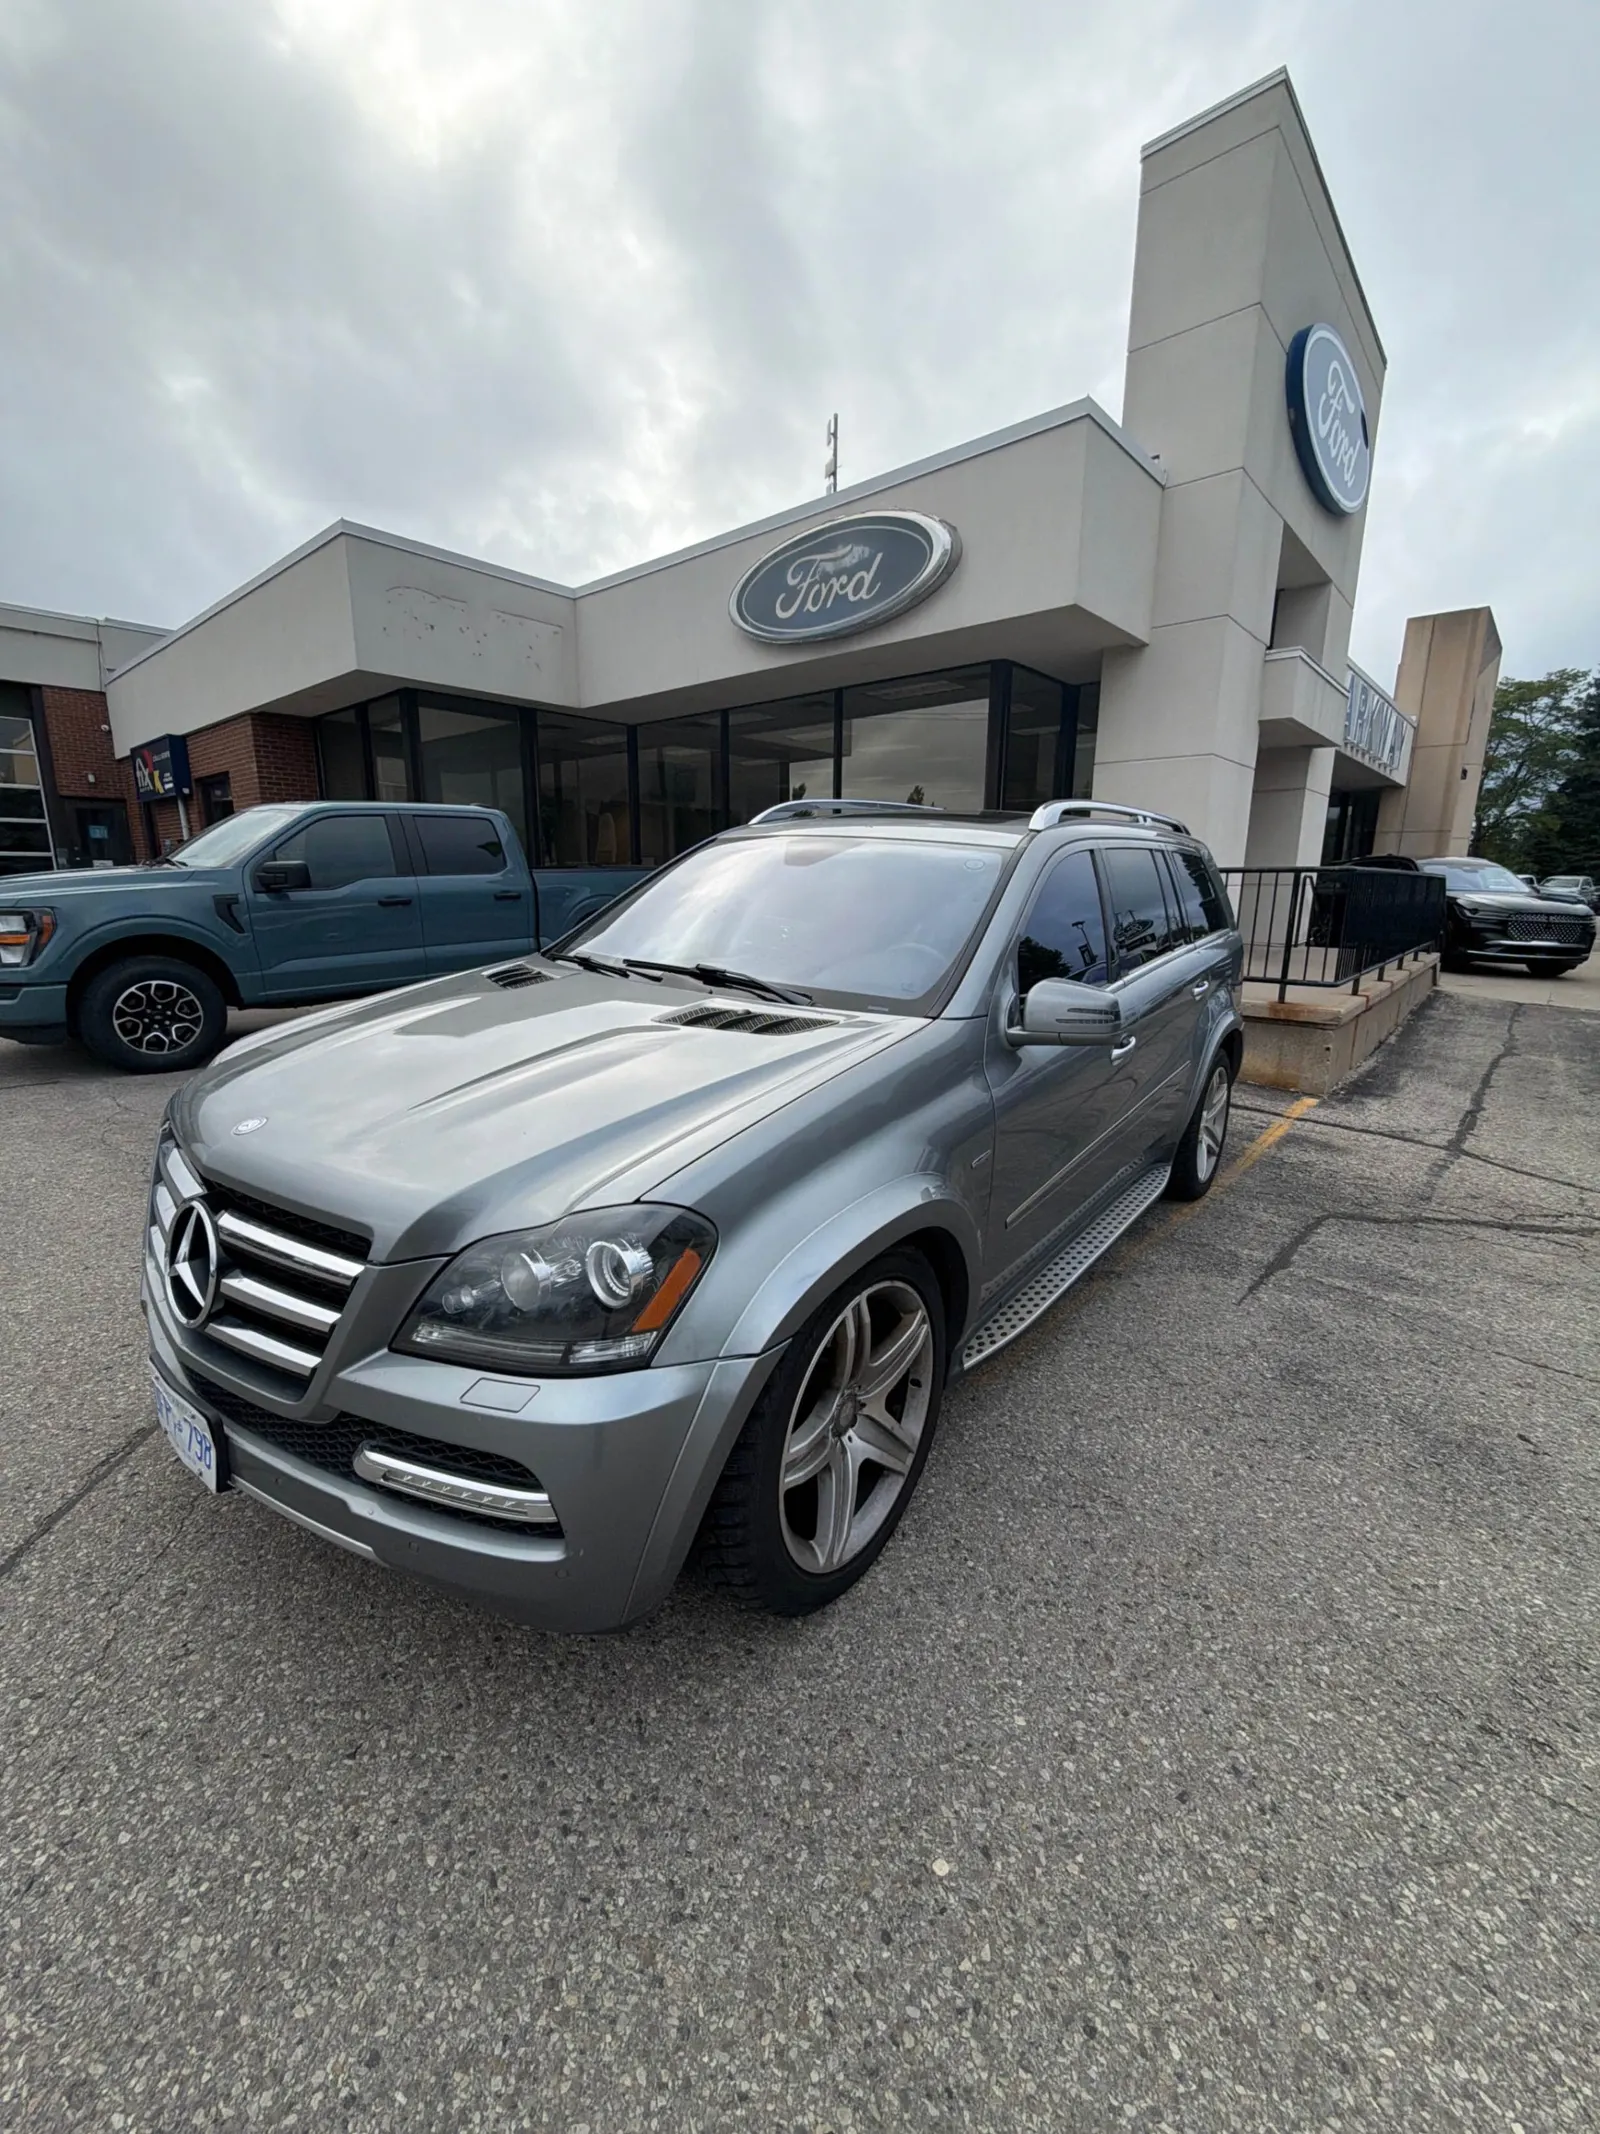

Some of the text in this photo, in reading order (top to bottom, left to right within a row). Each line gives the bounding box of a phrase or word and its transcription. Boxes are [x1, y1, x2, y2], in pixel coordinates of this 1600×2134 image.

[1318, 360, 1361, 488] Ford
[775, 544, 883, 619] Ford
[183, 1416, 213, 1470] 798
